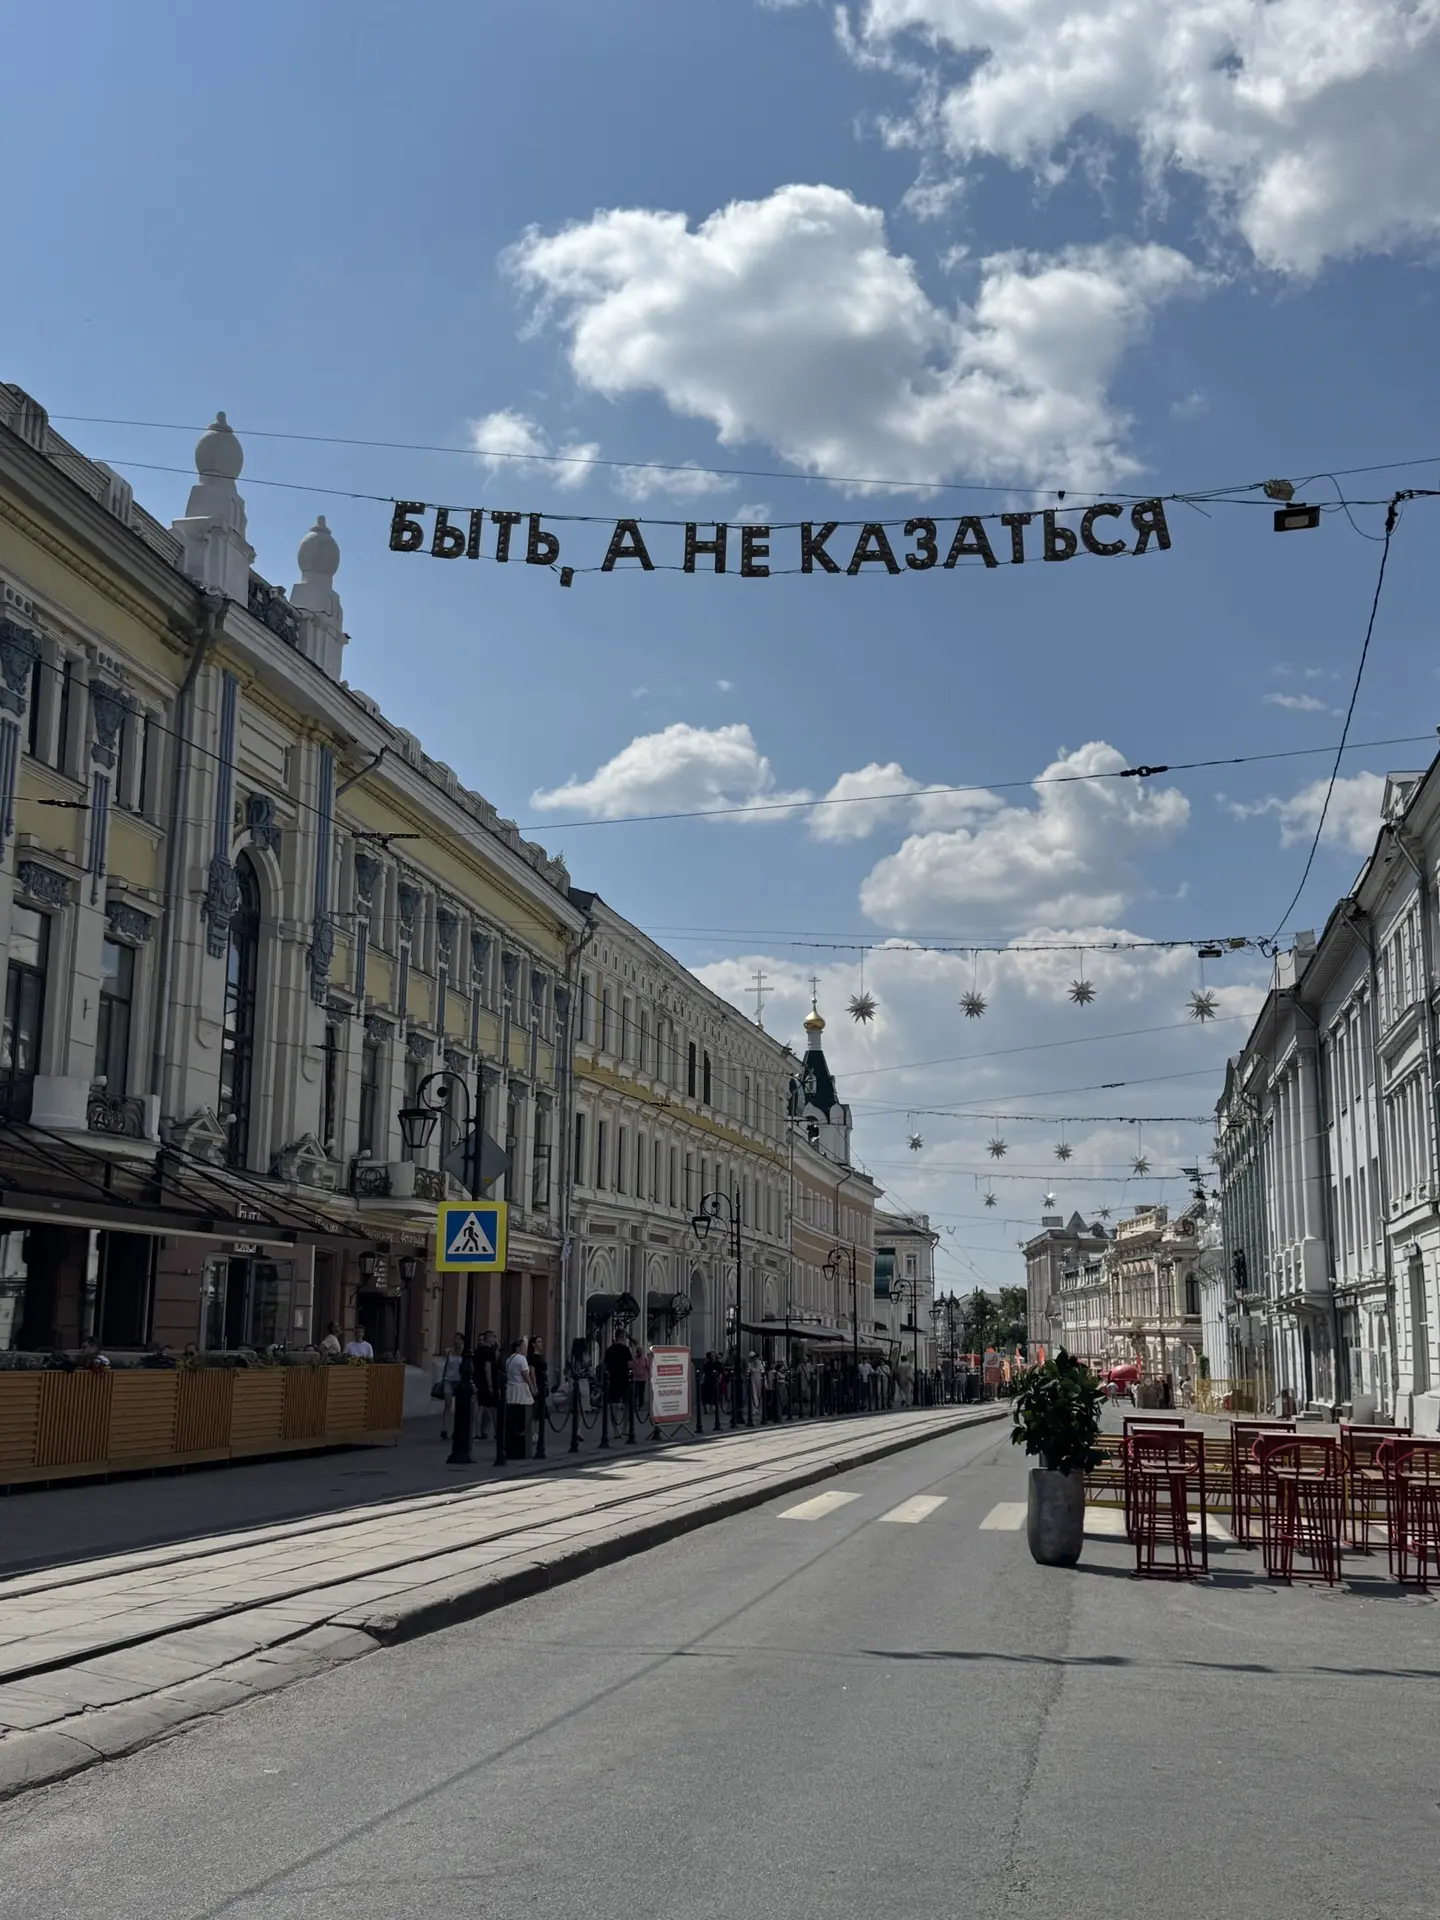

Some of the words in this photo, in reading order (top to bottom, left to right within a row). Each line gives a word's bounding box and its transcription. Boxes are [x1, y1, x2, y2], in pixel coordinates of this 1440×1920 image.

[388, 499, 573, 587] БЫТЬ,
[600, 518, 655, 572] А
[684, 522, 771, 578] НЕ
[801, 496, 1173, 576] КАЗАТЬСЯ
